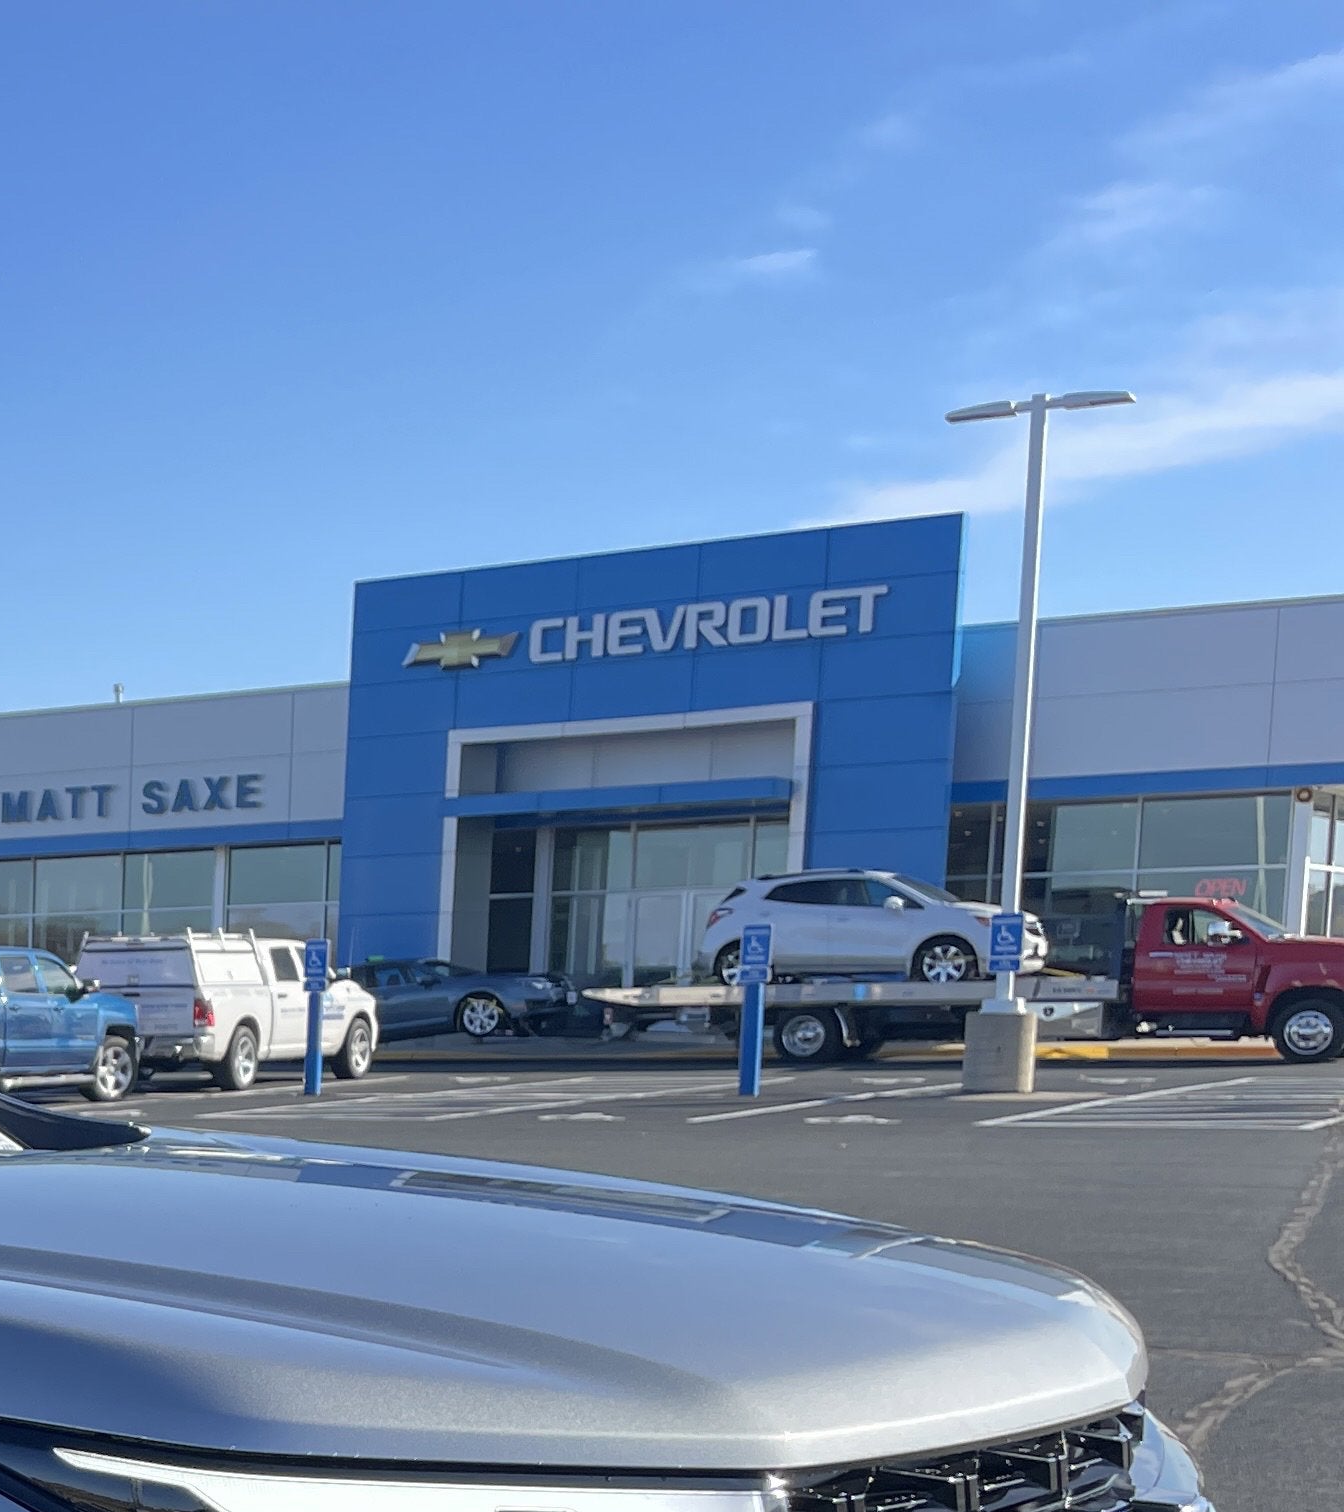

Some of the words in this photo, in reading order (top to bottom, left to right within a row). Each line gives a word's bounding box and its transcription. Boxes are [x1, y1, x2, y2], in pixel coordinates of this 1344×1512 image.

[528, 584, 889, 665] CHEVROLET
[0, 783, 116, 823] MATT
[141, 773, 265, 815] SAXE
[1194, 878, 1248, 897] OPEN
